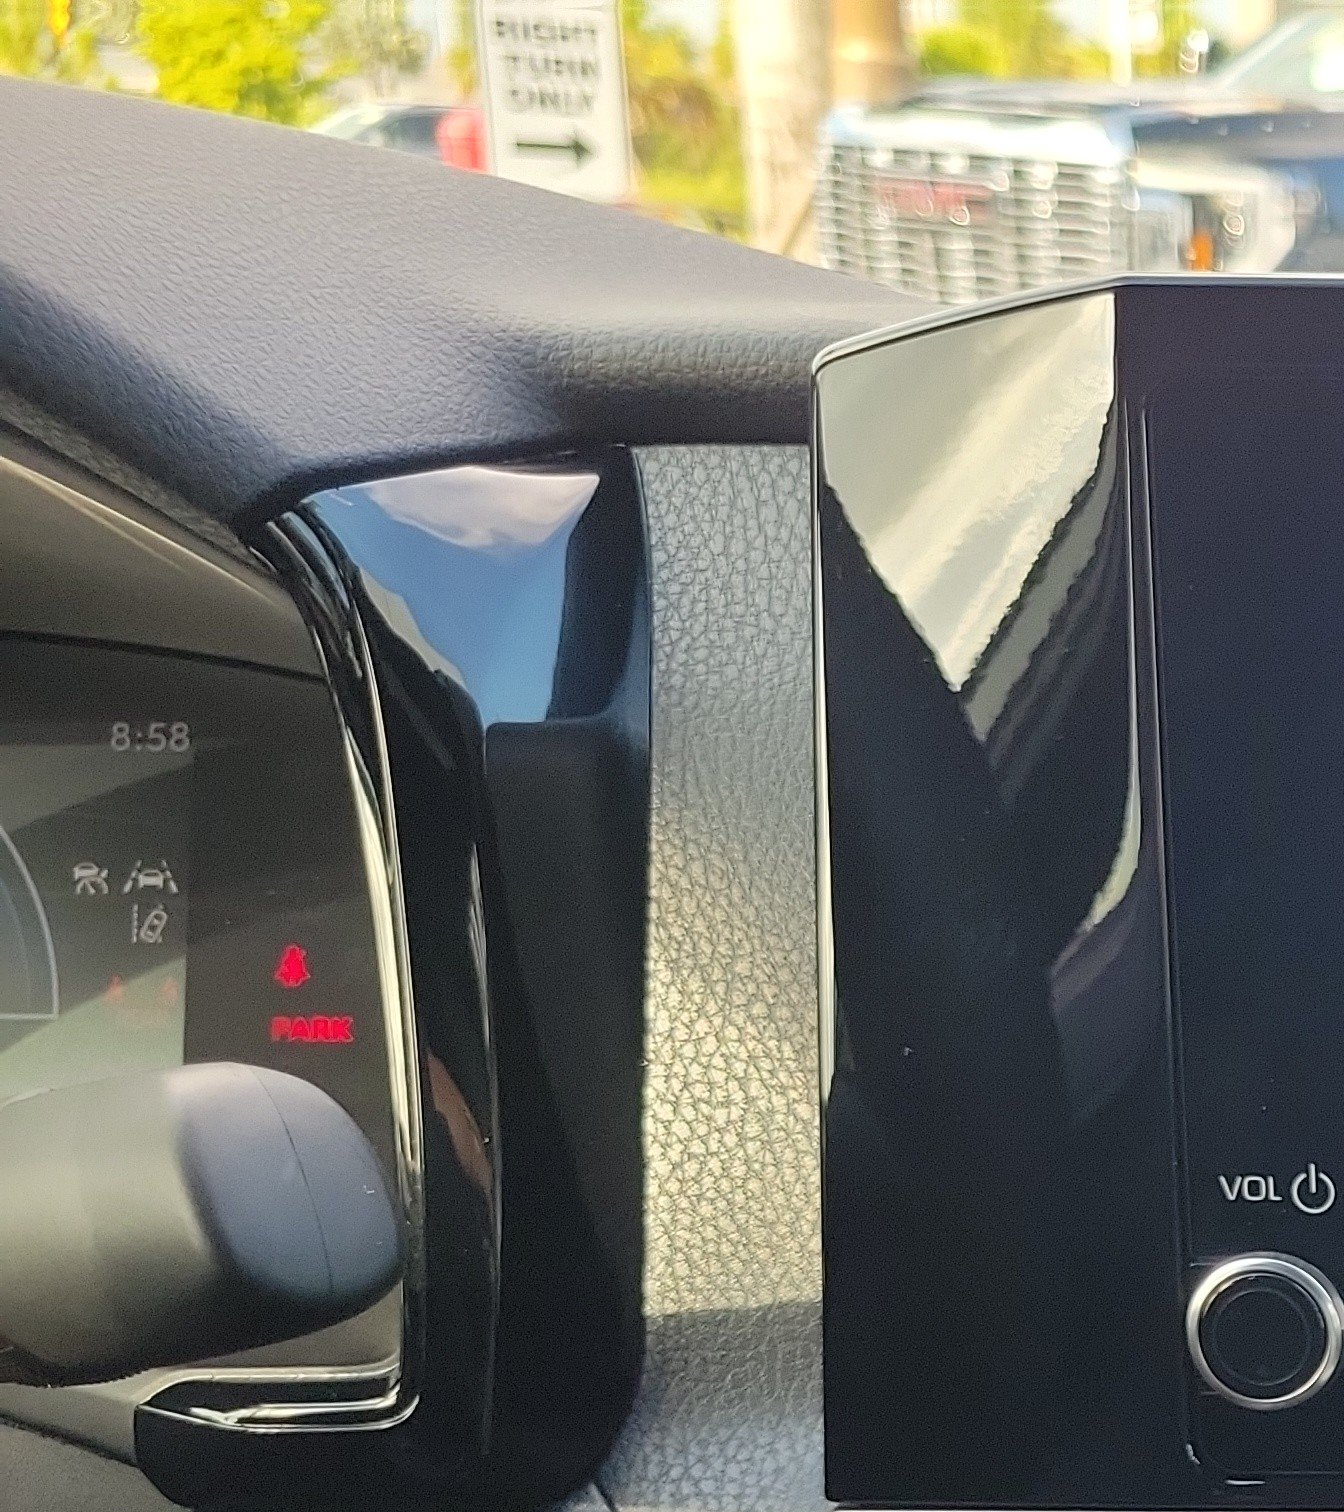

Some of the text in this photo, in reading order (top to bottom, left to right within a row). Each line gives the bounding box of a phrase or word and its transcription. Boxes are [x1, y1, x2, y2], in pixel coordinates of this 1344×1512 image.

[495, 19, 598, 44] RIGHT
[503, 54, 600, 78] TURN
[509, 88, 598, 114] ONLY
[110, 721, 191, 753] 8:58
[271, 1016, 354, 1043] PARK
[1217, 1174, 1283, 1202] VOL
